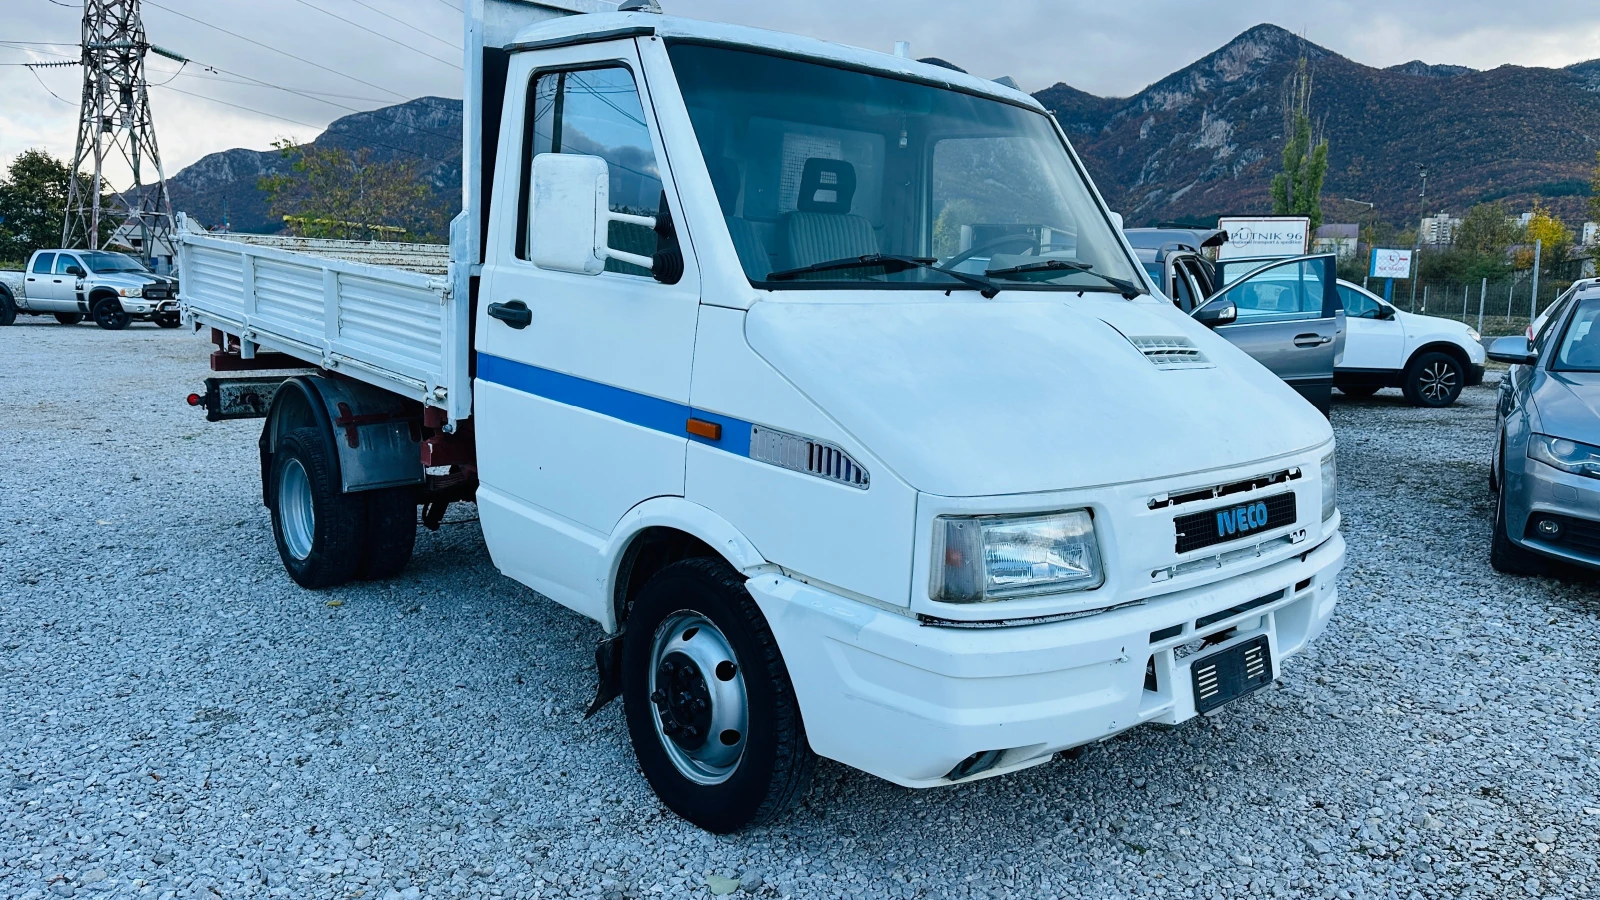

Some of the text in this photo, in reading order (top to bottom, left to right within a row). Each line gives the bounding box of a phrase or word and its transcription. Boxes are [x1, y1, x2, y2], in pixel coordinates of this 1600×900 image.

[1228, 232, 1303, 240] PUTNIK 96
[1217, 502, 1267, 536] IVECO
